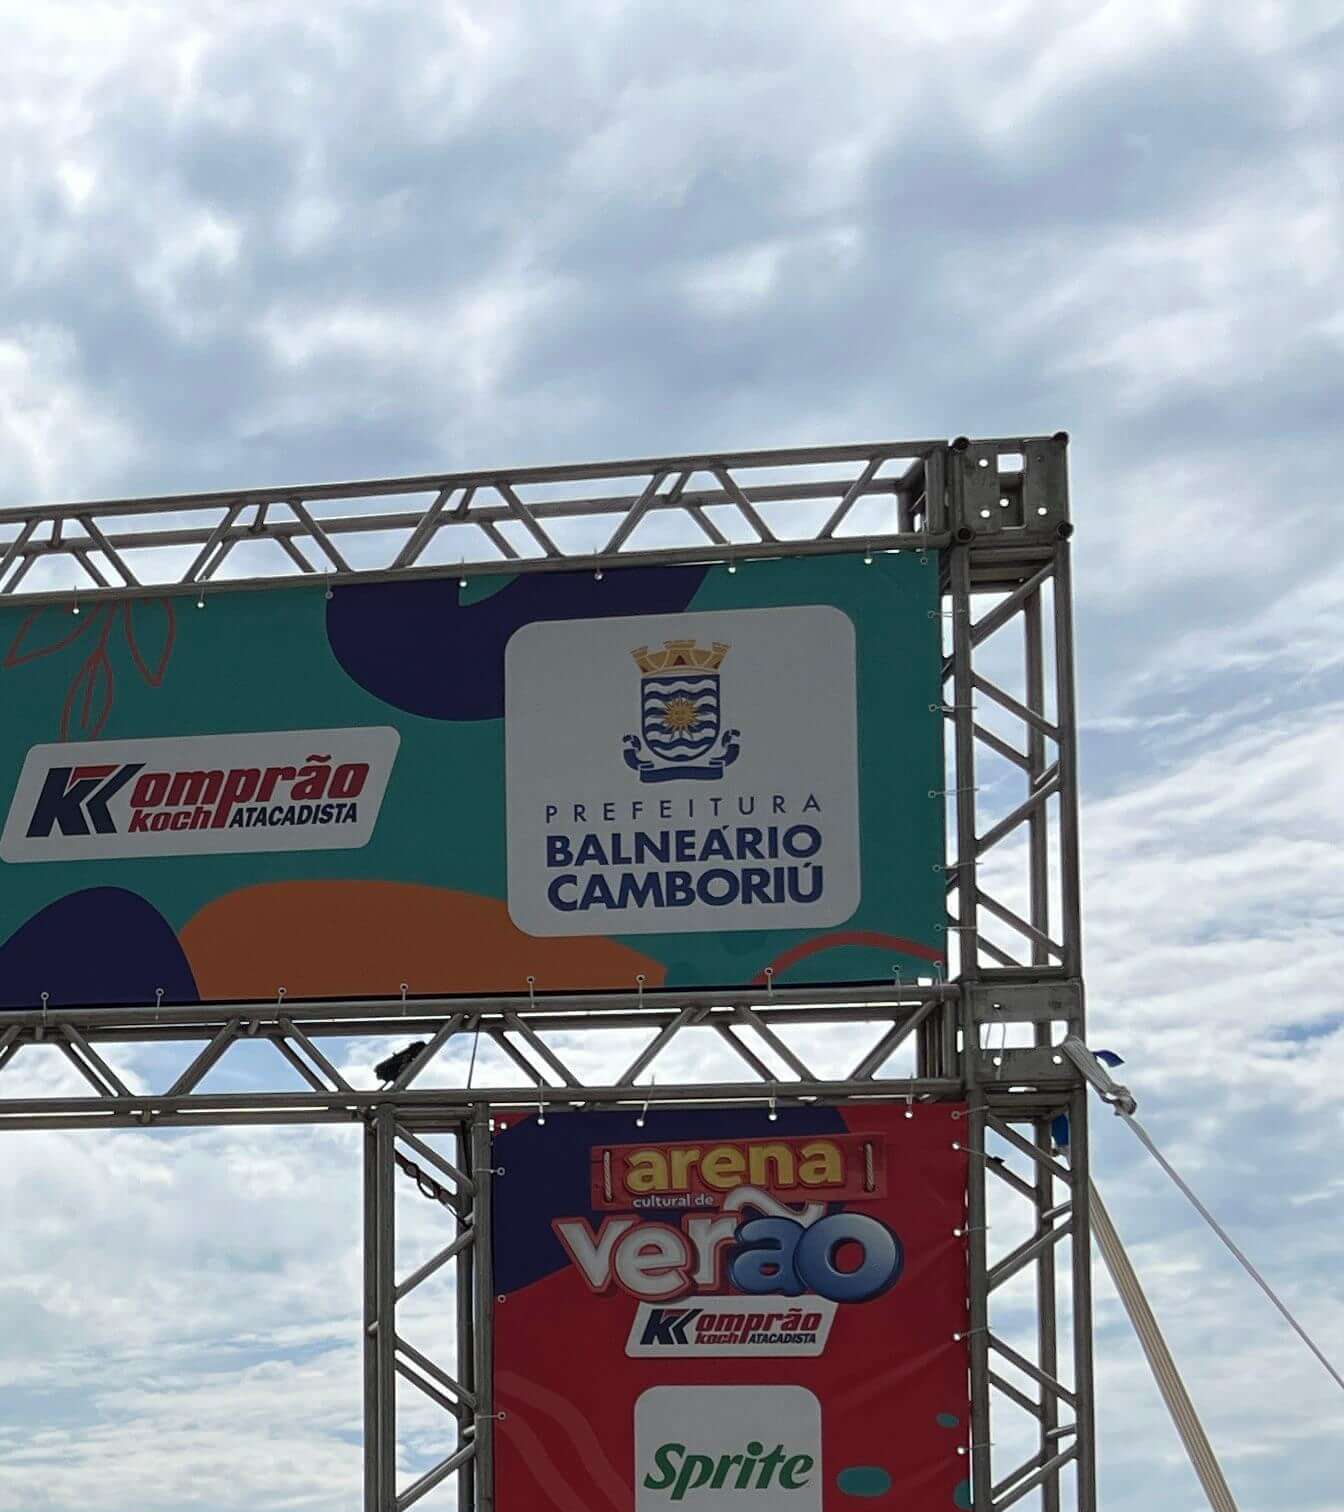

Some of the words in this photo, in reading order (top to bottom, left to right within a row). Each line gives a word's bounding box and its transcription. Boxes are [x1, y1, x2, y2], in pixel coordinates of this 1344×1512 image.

[228, 803, 358, 829] ATACADISTA
[544, 793, 822, 824] PREFEITURA
[546, 825, 823, 868] BALNEÁRIO
[547, 862, 824, 912] CAMBORIÚ
[624, 1139, 847, 1194] arena
[632, 1194, 690, 1208] cultural
[694, 1193, 714, 1206] de
[552, 1185, 902, 1303] verão
[748, 1333, 816, 1345] ATACADISTA
[644, 1441, 815, 1501] Sprite
